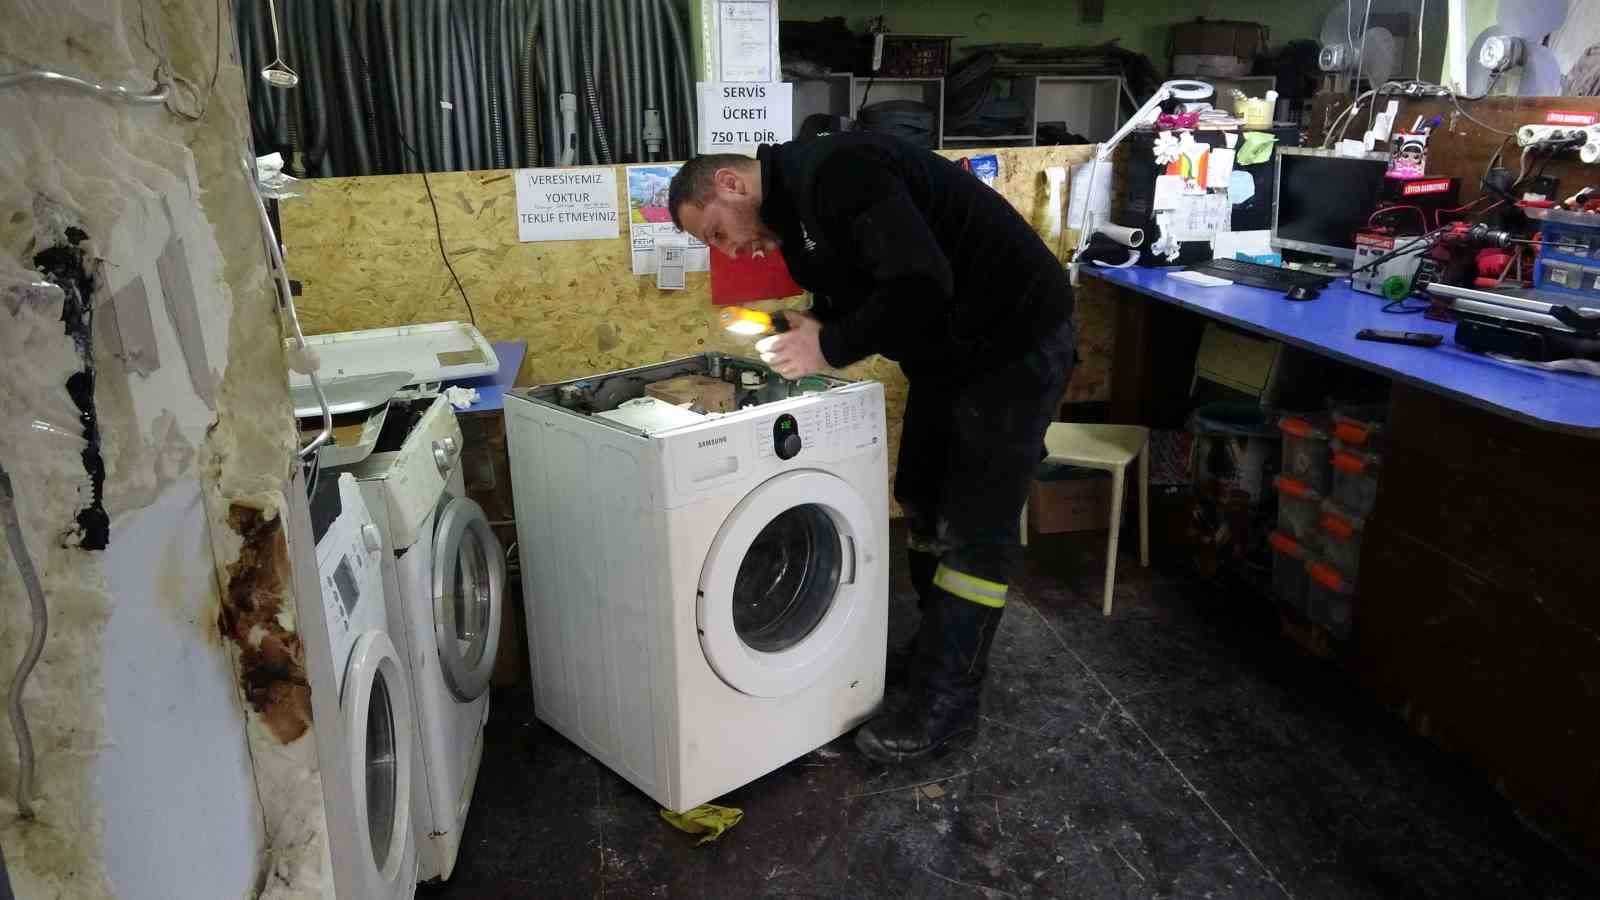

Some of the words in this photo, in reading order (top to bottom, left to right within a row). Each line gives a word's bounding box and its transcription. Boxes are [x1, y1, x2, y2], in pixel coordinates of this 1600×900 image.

[723, 84, 766, 98] SERVİS
[723, 106, 767, 120] ÜCRETİ
[711, 131, 734, 143] 750
[736, 131, 750, 142] TL
[754, 129, 778, 143] DİR.
[545, 193, 590, 203] YOKTUR
[697, 435, 728, 448] SAMSUNG
